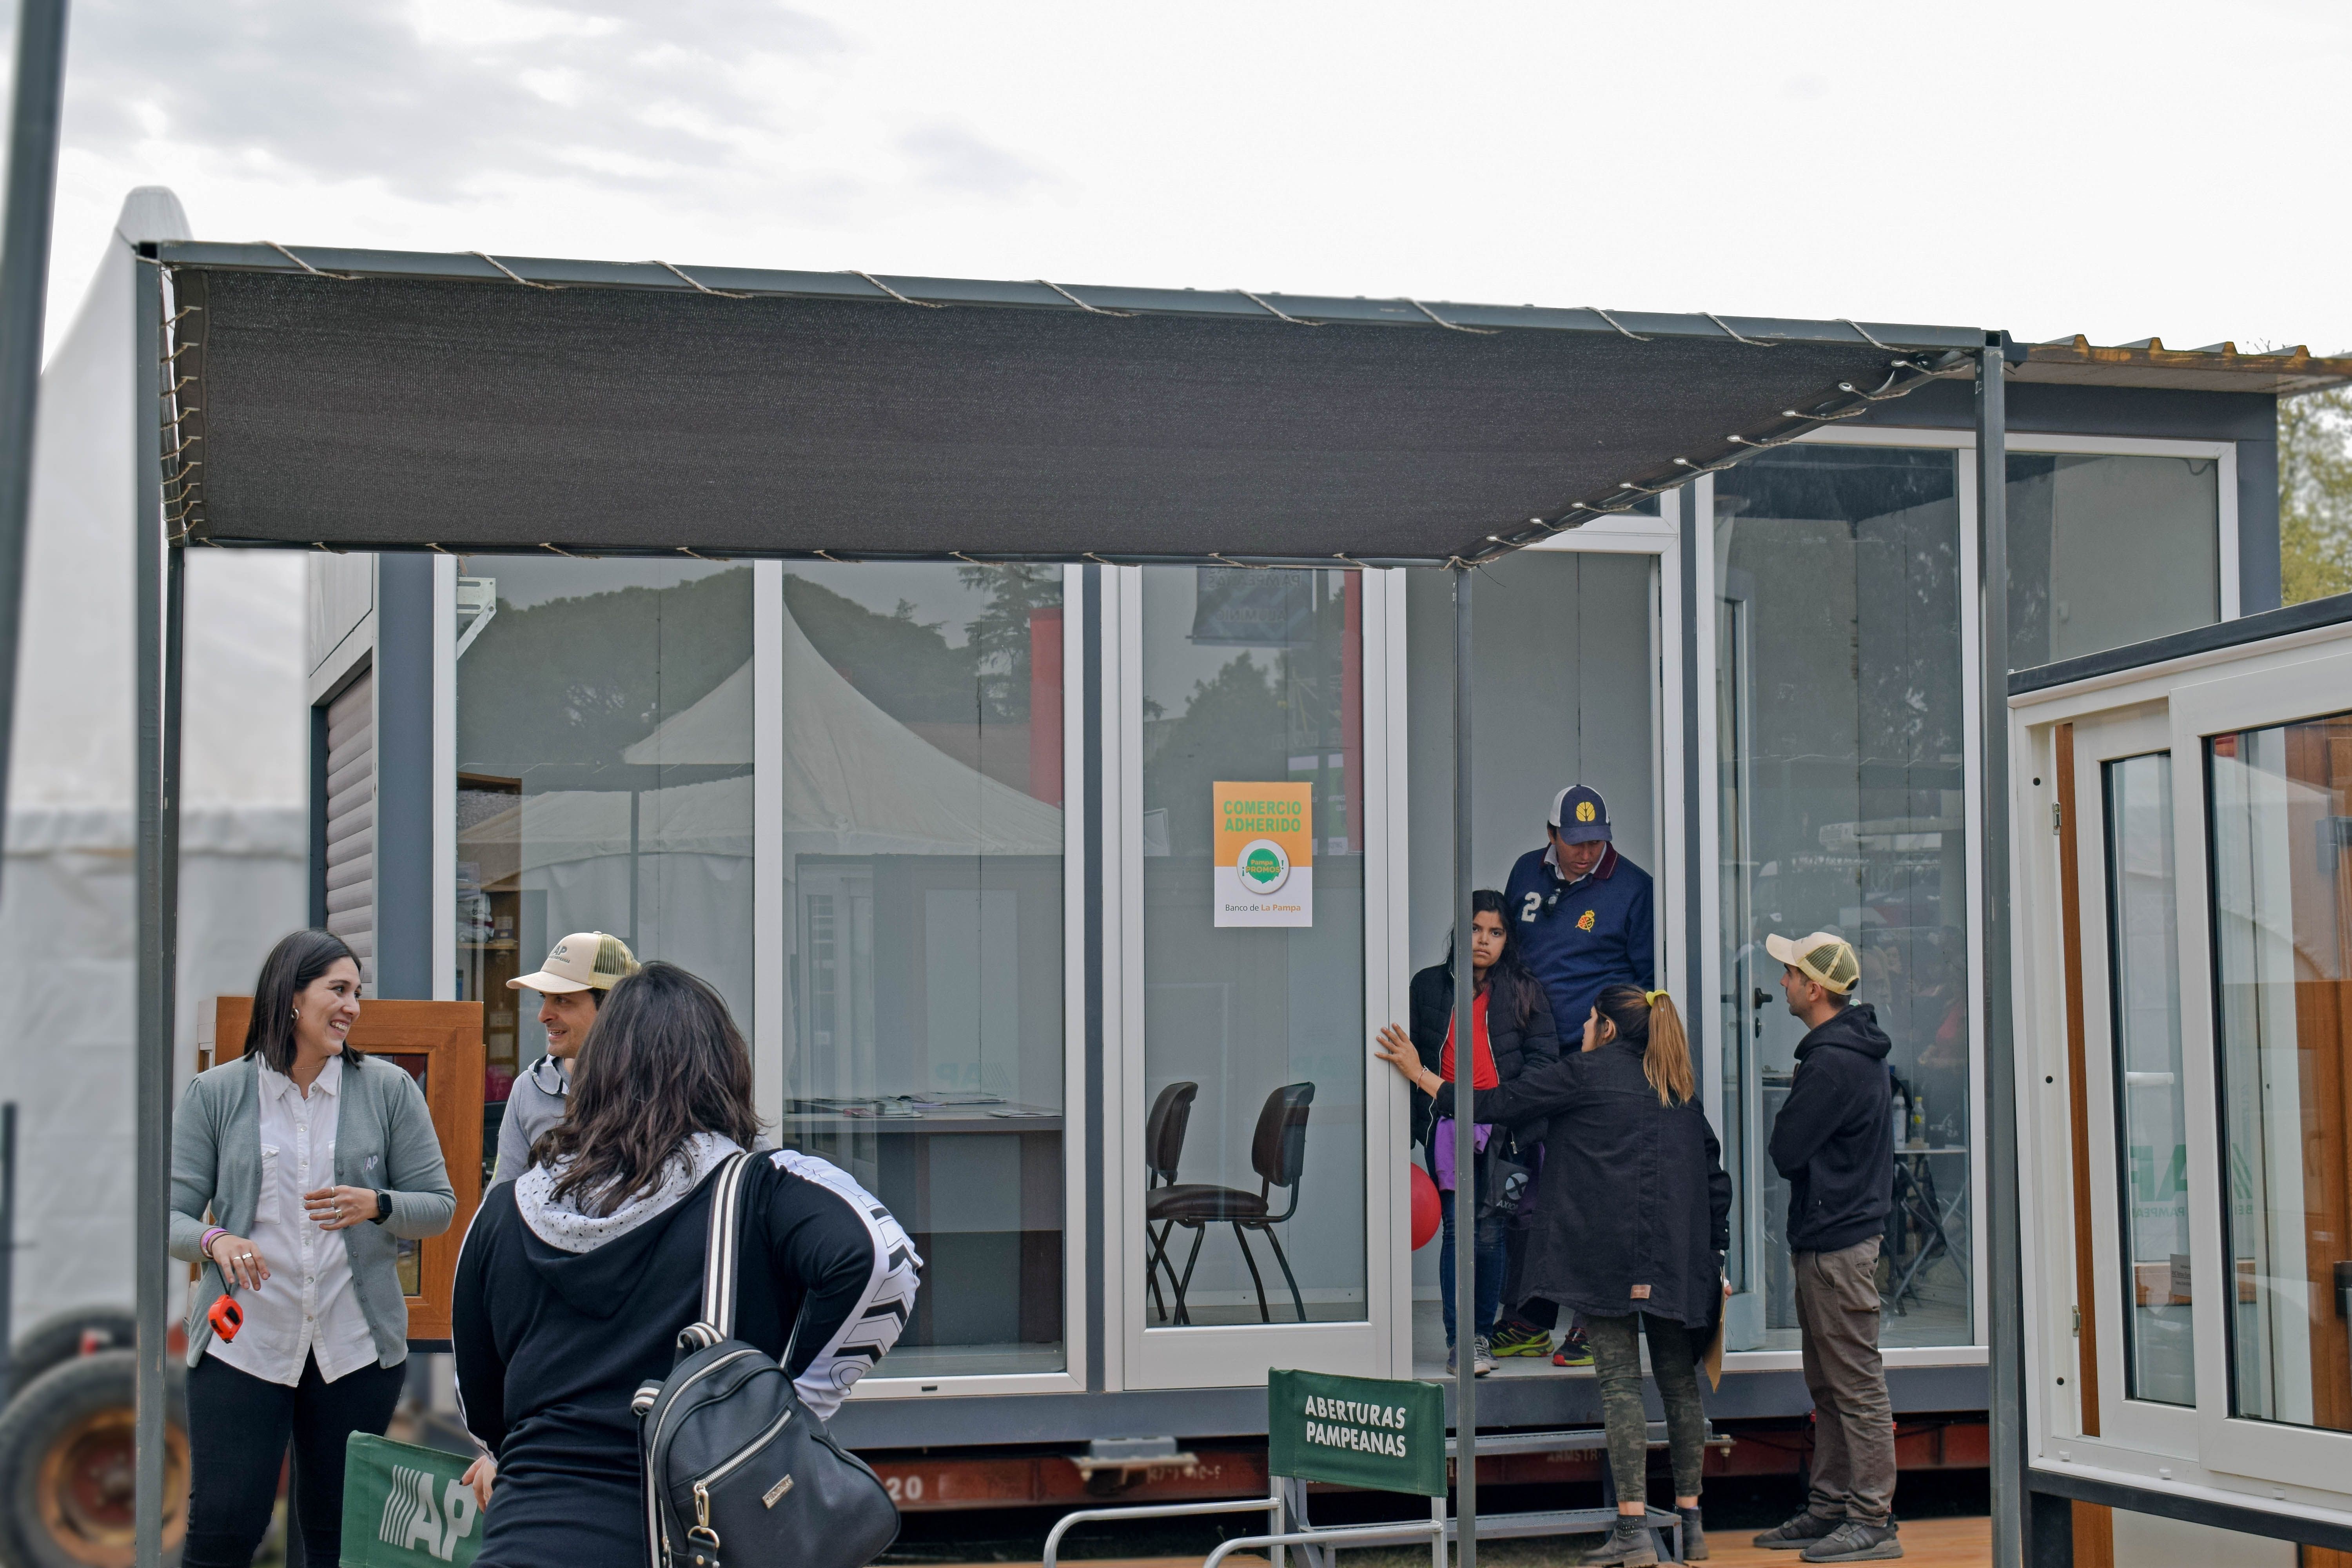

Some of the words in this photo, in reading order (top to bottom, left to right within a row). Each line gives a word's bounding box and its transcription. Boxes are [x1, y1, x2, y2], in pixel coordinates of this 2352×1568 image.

[1223, 801, 1301, 815] COMERCIO
[1224, 818, 1301, 832] ADHERIDO
[1273, 904, 1301, 913] Pampa
[1521, 891, 1541, 922] 2
[366, 1155, 378, 1171] AP
[1305, 1395, 1406, 1429] ABERTURAS
[1307, 1421, 1405, 1457] PAMPEANAS
[405, 1472, 478, 1562] AP
